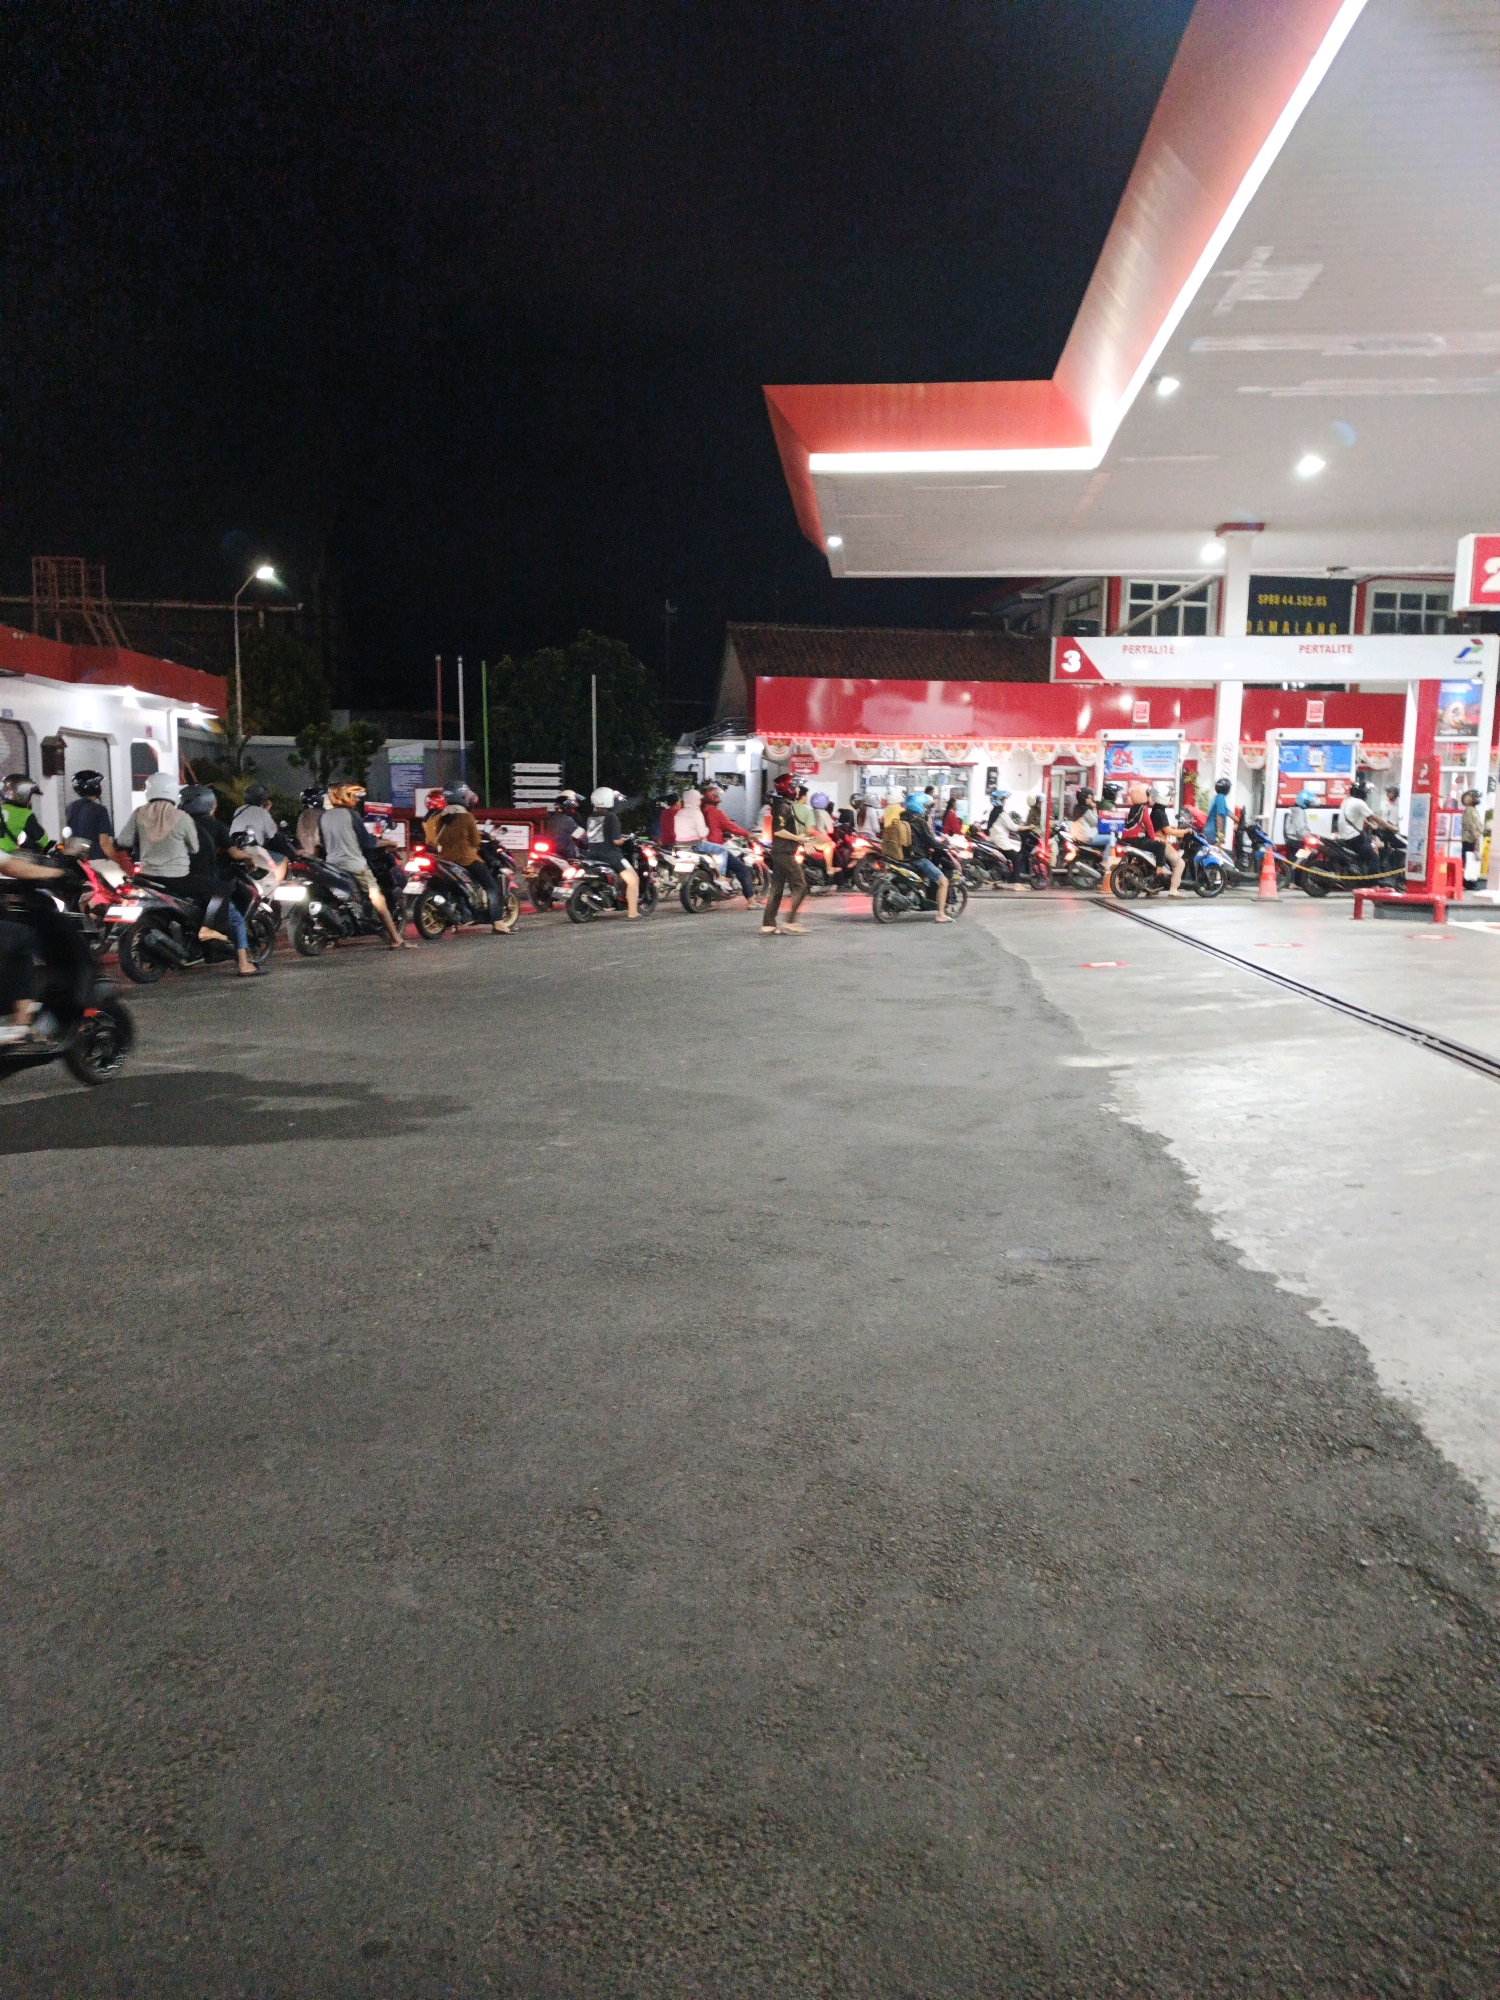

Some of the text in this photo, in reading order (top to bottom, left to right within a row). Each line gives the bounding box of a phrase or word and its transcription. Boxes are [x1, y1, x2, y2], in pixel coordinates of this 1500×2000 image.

[1122, 645, 1175, 654] PERTALITE
[1299, 644, 1354, 654] PERTALITE
[1061, 650, 1081, 673] 3
